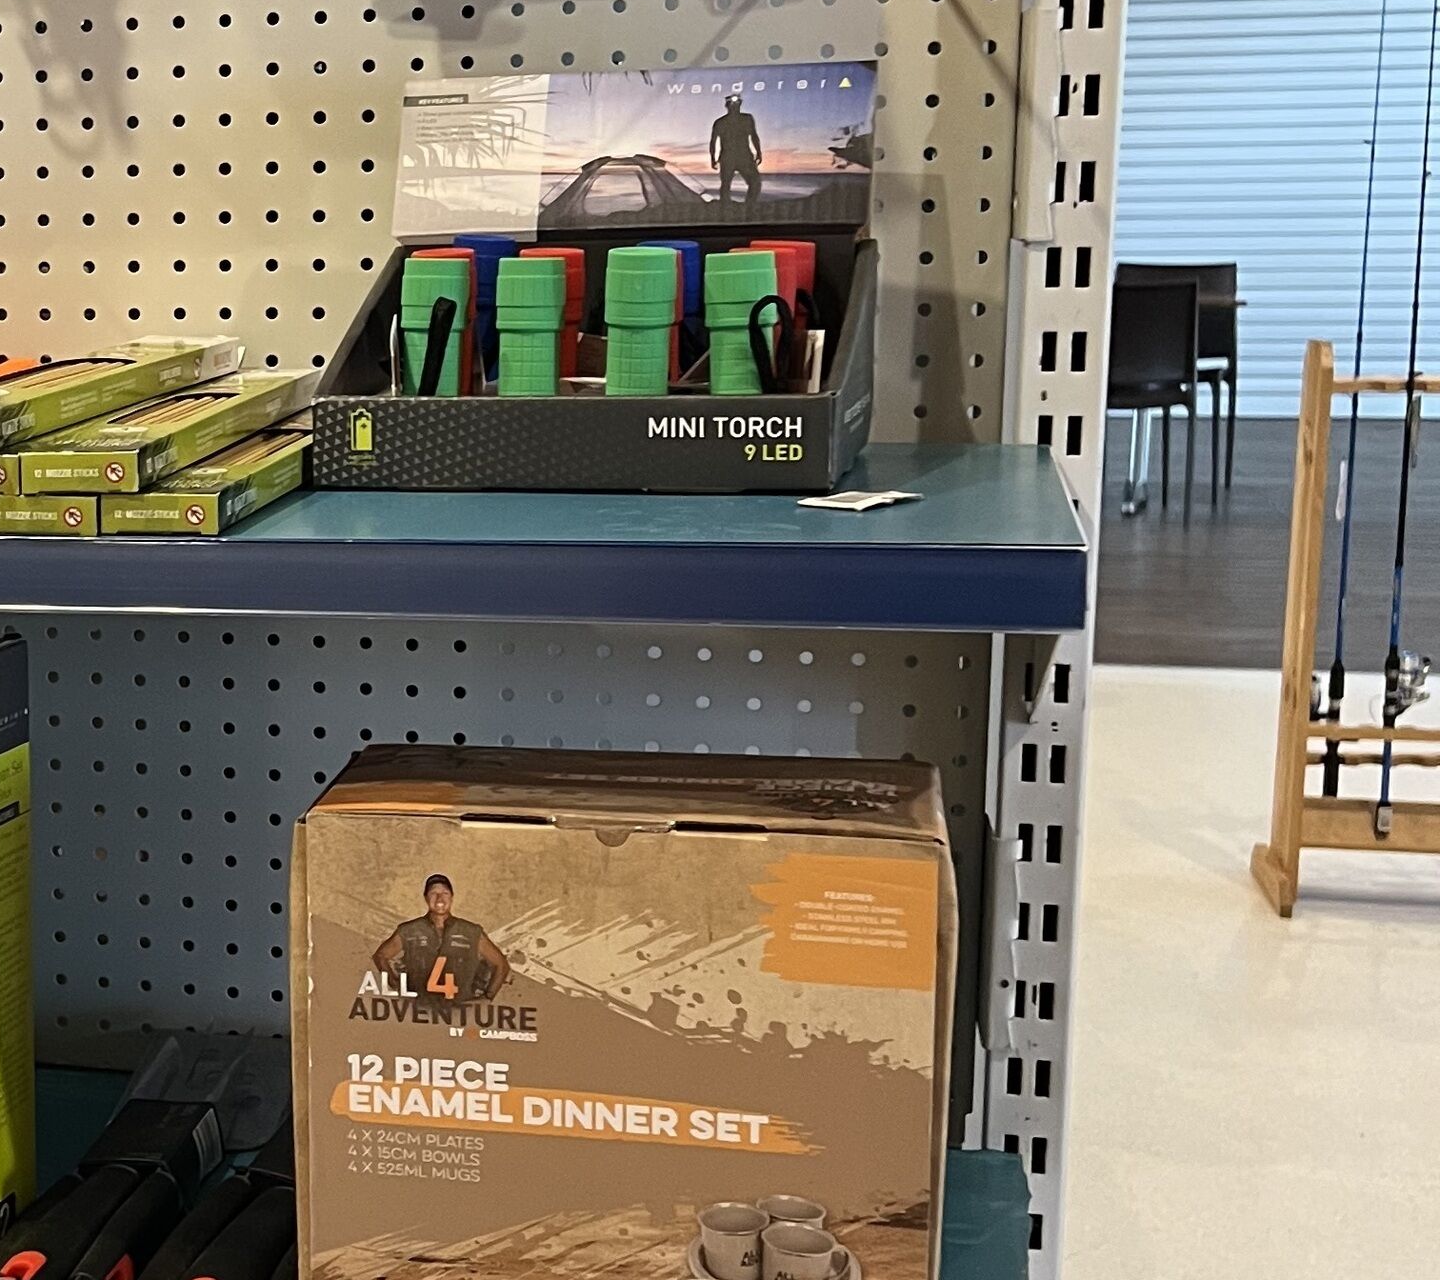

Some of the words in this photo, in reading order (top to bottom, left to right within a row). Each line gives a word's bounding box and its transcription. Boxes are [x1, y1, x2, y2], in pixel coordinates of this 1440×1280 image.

[666, 77, 827, 95] Wanderer
[648, 417, 706, 438] MINI
[713, 417, 803, 438] TORCH
[745, 445, 757, 461] 9
[762, 444, 803, 461] LED
[358, 971, 418, 998] ALL
[426, 956, 459, 1000] 4
[348, 997, 538, 1032] ADVENTURE
[449, 1027, 465, 1037] BY
[479, 1029, 538, 1042] CAMPBOSS
[347, 1053, 384, 1083] 12
[395, 1056, 510, 1092] PIECE
[349, 1083, 514, 1124] ENAMEL
[523, 1096, 679, 1137] DINNER
[689, 1110, 769, 1145] SET
[347, 1129, 357, 1140] 4
[377, 1129, 421, 1146] 24CM
[425, 1134, 485, 1151] PLATES
[347, 1145, 357, 1157] 4
[377, 1146, 417, 1161] 15CM
[422, 1149, 481, 1167] BOWLS
[347, 1162, 357, 1173] 4
[377, 1162, 427, 1178] 525ML
[432, 1166, 481, 1183] MUGS
